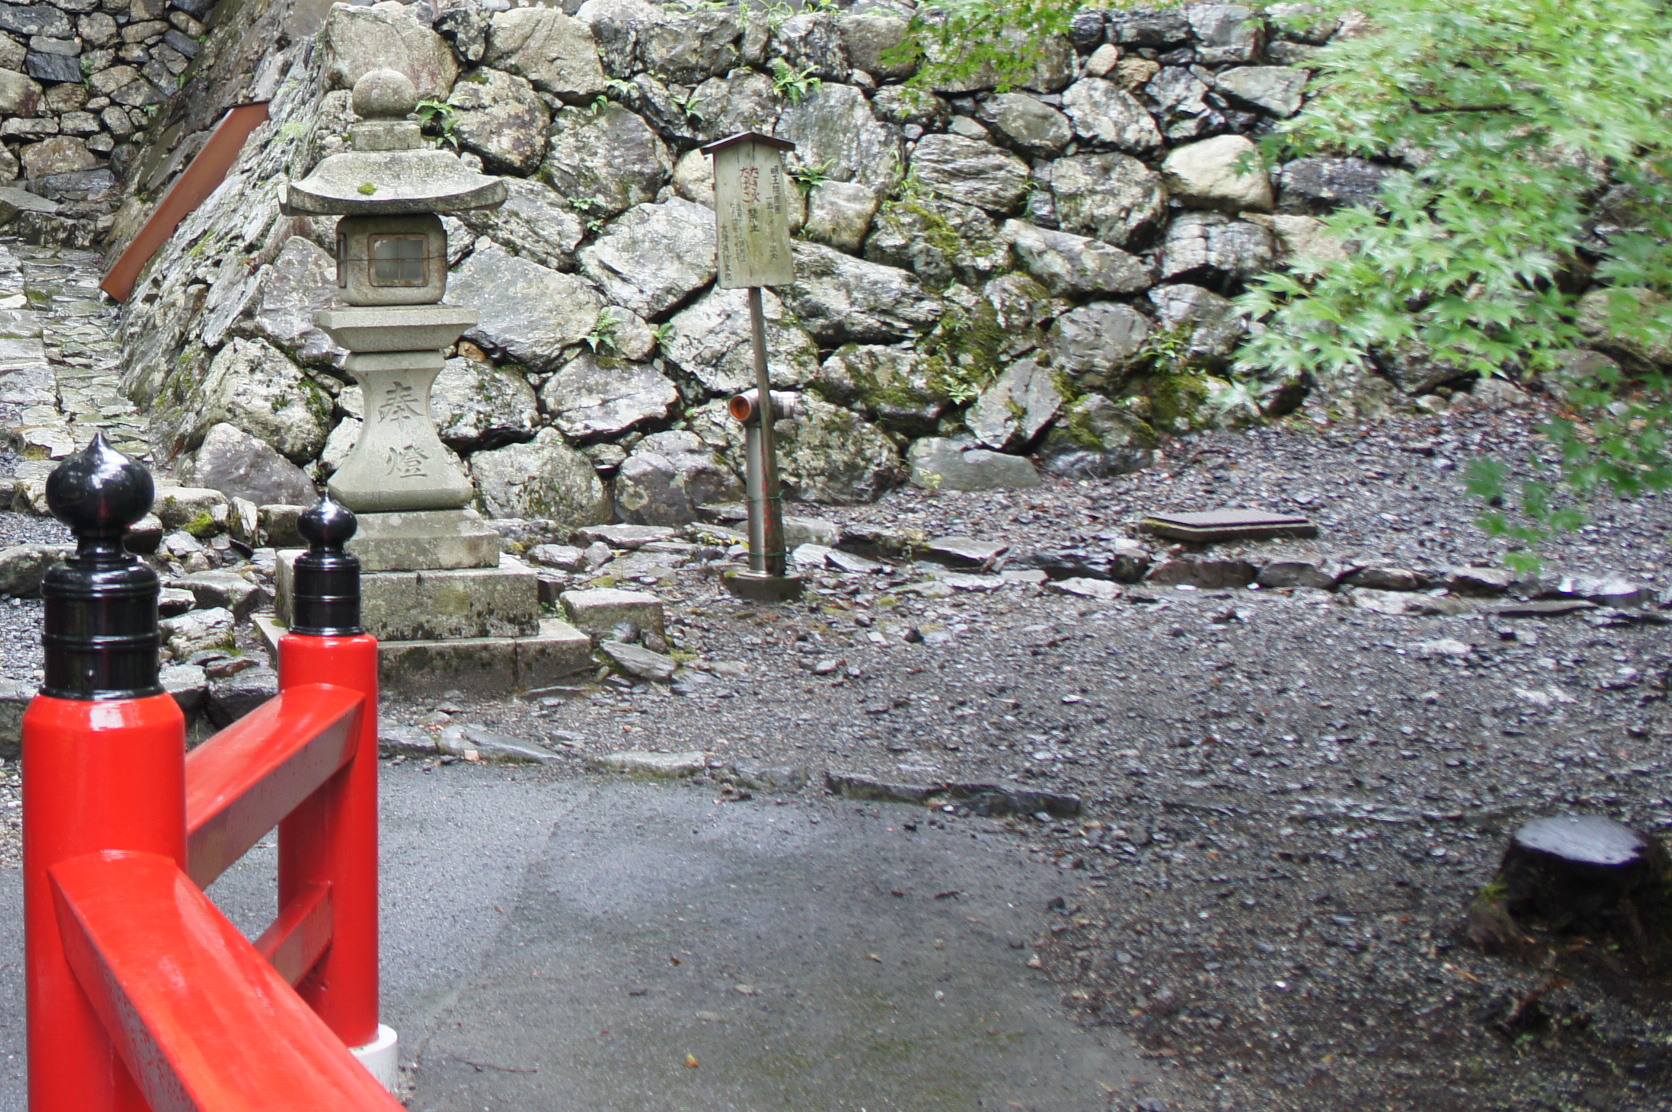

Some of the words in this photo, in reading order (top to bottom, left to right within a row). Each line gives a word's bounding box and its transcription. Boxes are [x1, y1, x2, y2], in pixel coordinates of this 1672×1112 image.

[739, 166, 750, 203] たばこ
[749, 166, 761, 203] たき火
